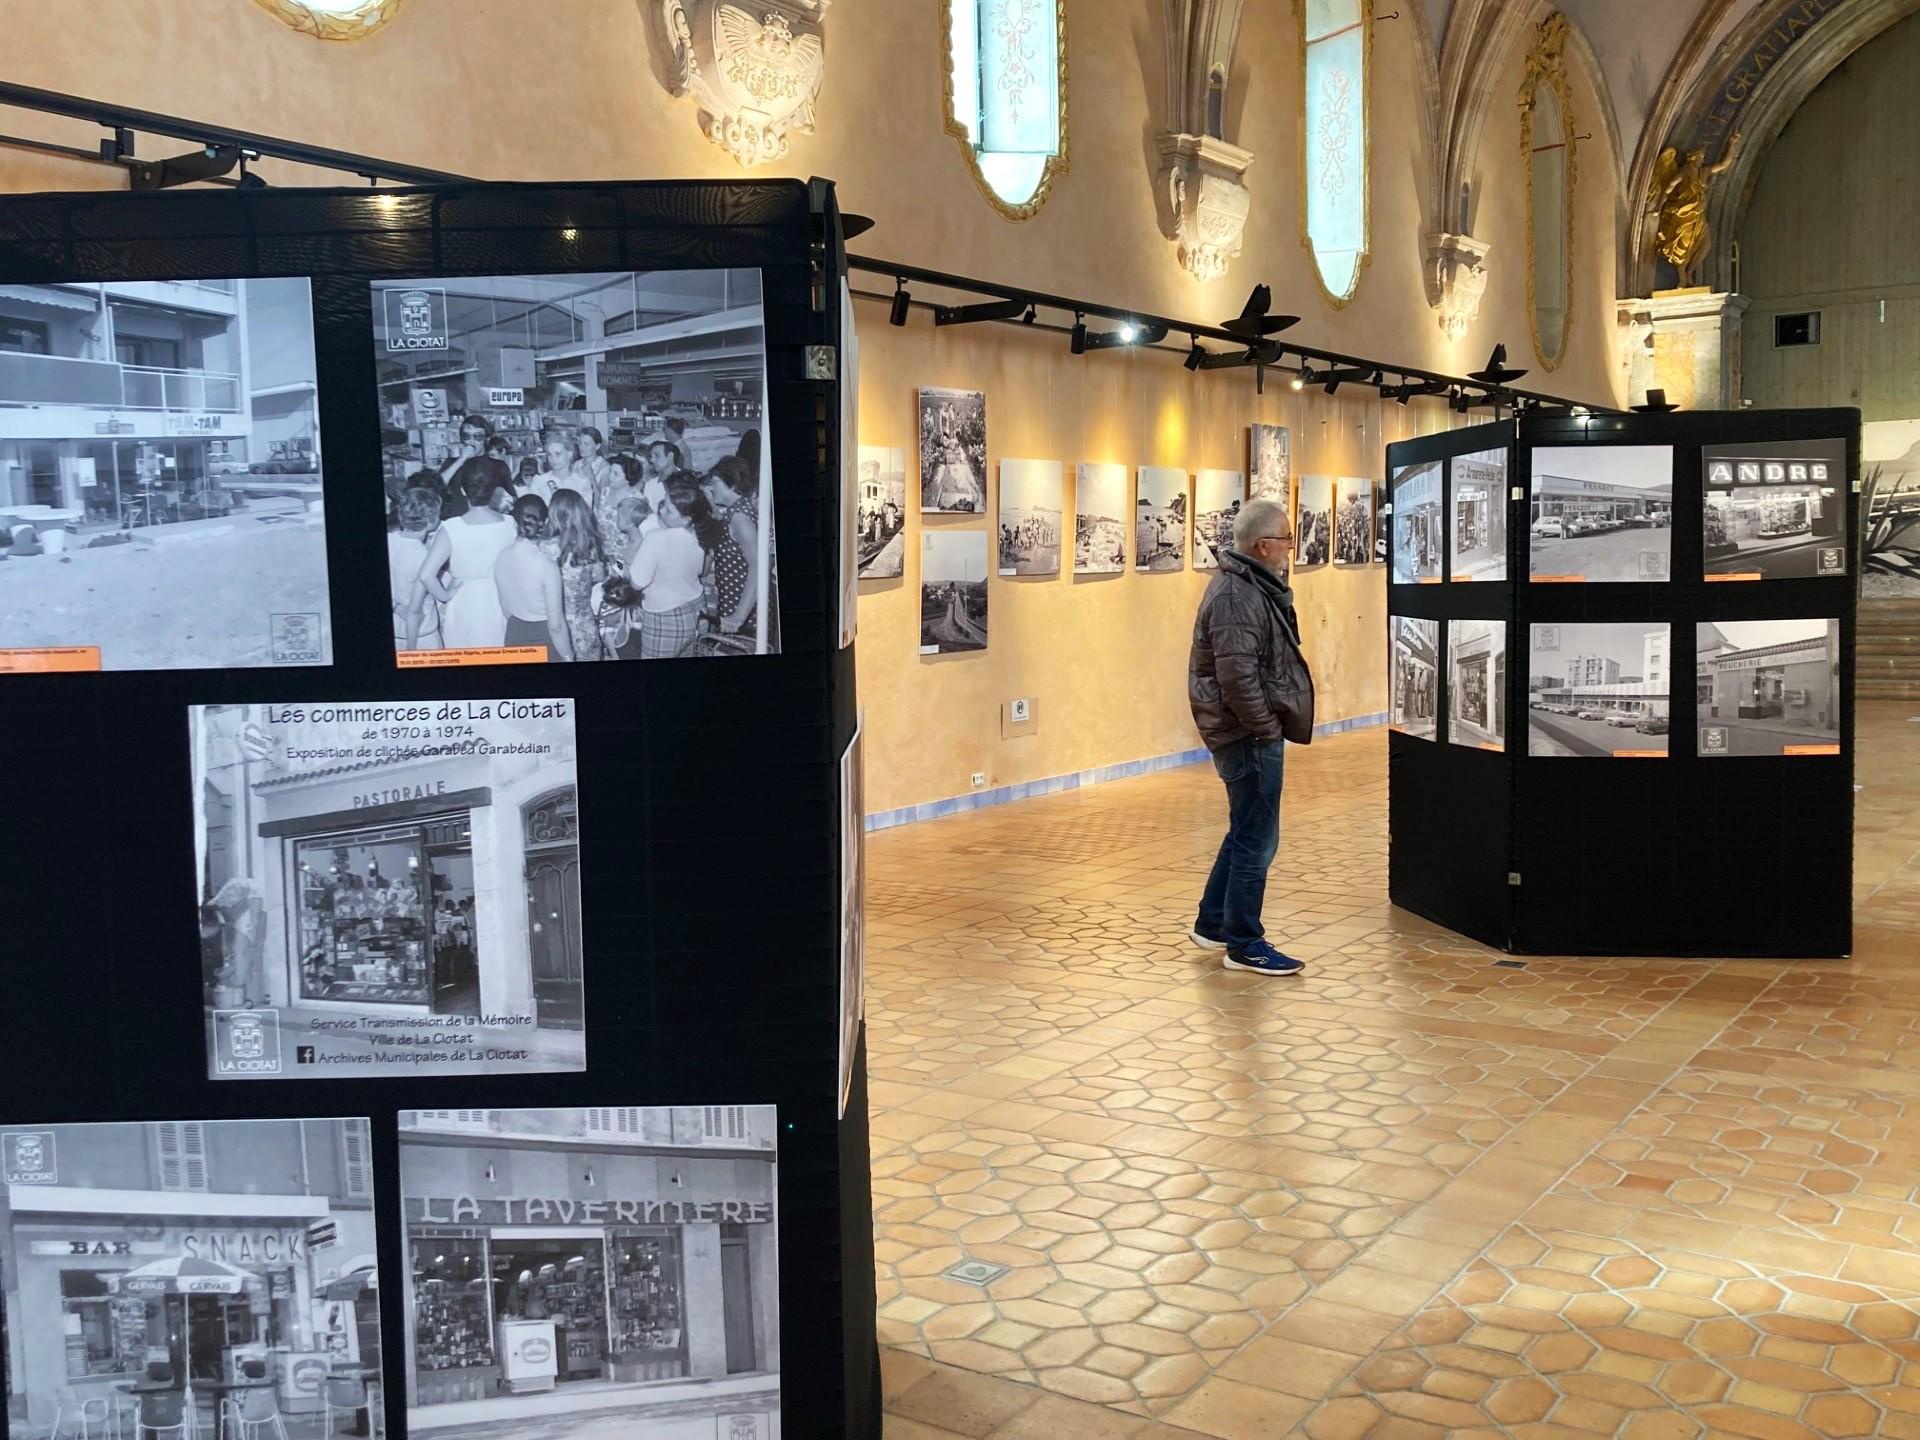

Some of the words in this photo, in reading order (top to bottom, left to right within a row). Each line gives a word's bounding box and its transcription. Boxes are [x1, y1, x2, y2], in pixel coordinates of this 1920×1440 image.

[390, 337, 405, 349] LA
[406, 336, 445, 349] CIOTAT
[491, 390, 522, 402] europa
[168, 415, 221, 430] TAM-TAM
[1709, 464, 1828, 481] ANDRE
[268, 705, 305, 724] Les
[310, 706, 431, 723] commerces
[436, 702, 462, 721] de
[467, 701, 491, 720] La
[497, 700, 567, 719] Ciotat
[361, 728, 378, 740] de
[382, 726, 420, 740] 1970
[422, 725, 431, 738] à
[434, 725, 474, 738] 1974
[286, 747, 353, 763] Exposition
[356, 747, 372, 759] de
[374, 744, 419, 758] clichés
[478, 742, 551, 755] Garabédian
[353, 780, 447, 810] PASTORALE
[311, 1017, 357, 1030] Service
[360, 1016, 443, 1029] Transmission
[445, 1016, 462, 1027] de
[465, 1015, 476, 1026] la
[478, 1013, 532, 1026] Mémoire
[369, 1034, 396, 1046] Ville
[398, 1033, 414, 1045] de
[415, 1034, 432, 1045] La
[433, 1032, 474, 1045] Ciotat
[318, 1053, 373, 1064] Archives
[375, 1051, 448, 1066] Municipales
[450, 1050, 466, 1062] de
[469, 1050, 486, 1061] La
[487, 1049, 529, 1061] Ciotat
[220, 1061, 236, 1072] LA
[238, 1059, 277, 1071] CIOTAT
[420, 1196, 482, 1224] LA
[495, 1197, 772, 1225] TAVERNIERE
[70, 1240, 134, 1255] BAR
[183, 1235, 303, 1262] SNACK
[128, 1280, 167, 1291] GERVAIS
[189, 1280, 232, 1292] GERVAIS
